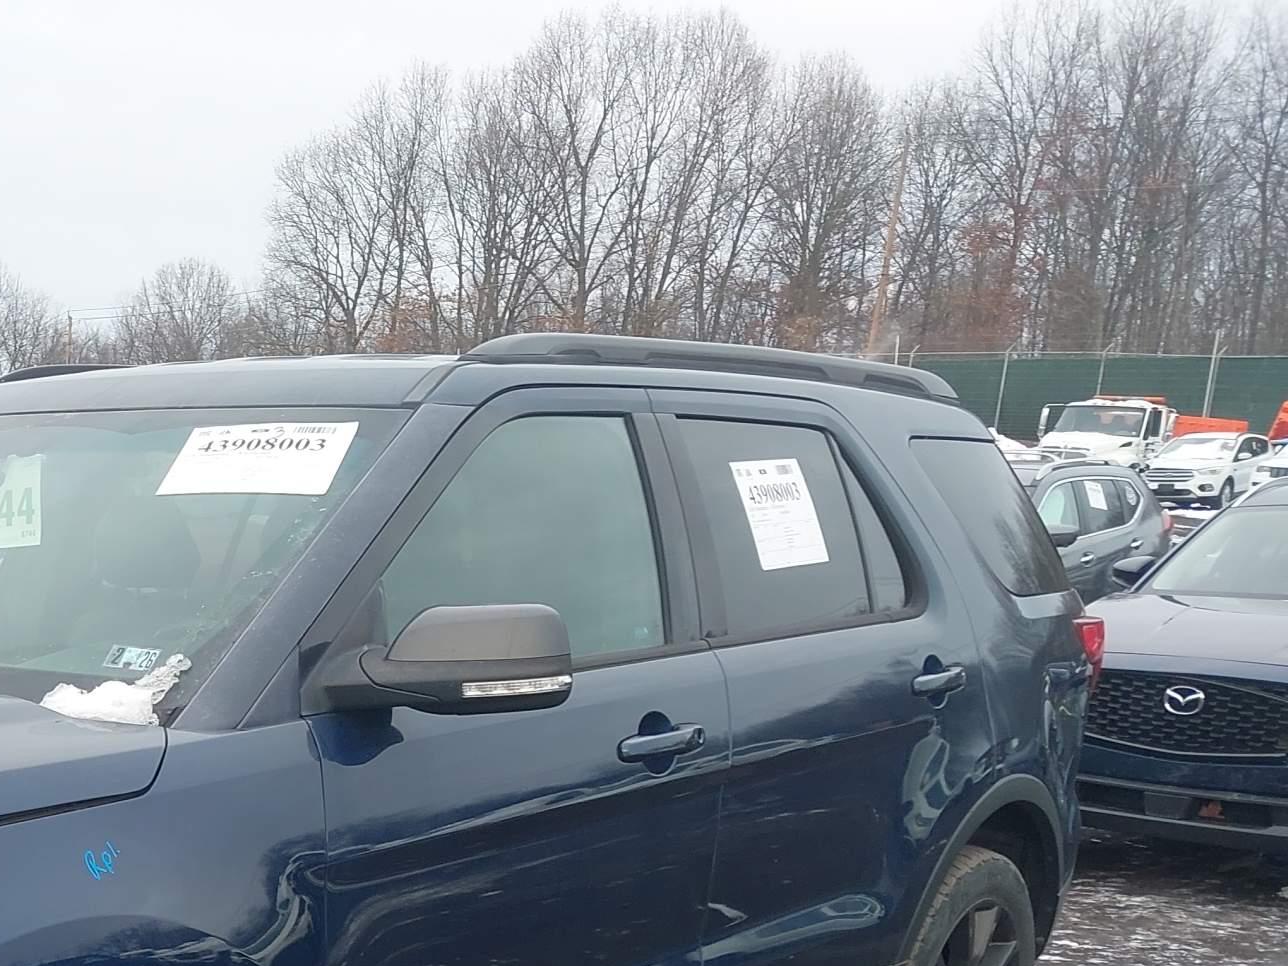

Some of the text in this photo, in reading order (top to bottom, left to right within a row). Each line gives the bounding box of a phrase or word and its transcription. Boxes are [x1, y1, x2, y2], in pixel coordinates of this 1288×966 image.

[197, 437, 327, 453] 43908003
[748, 482, 801, 504] 43908003
[110, 647, 158, 669] 2 26
